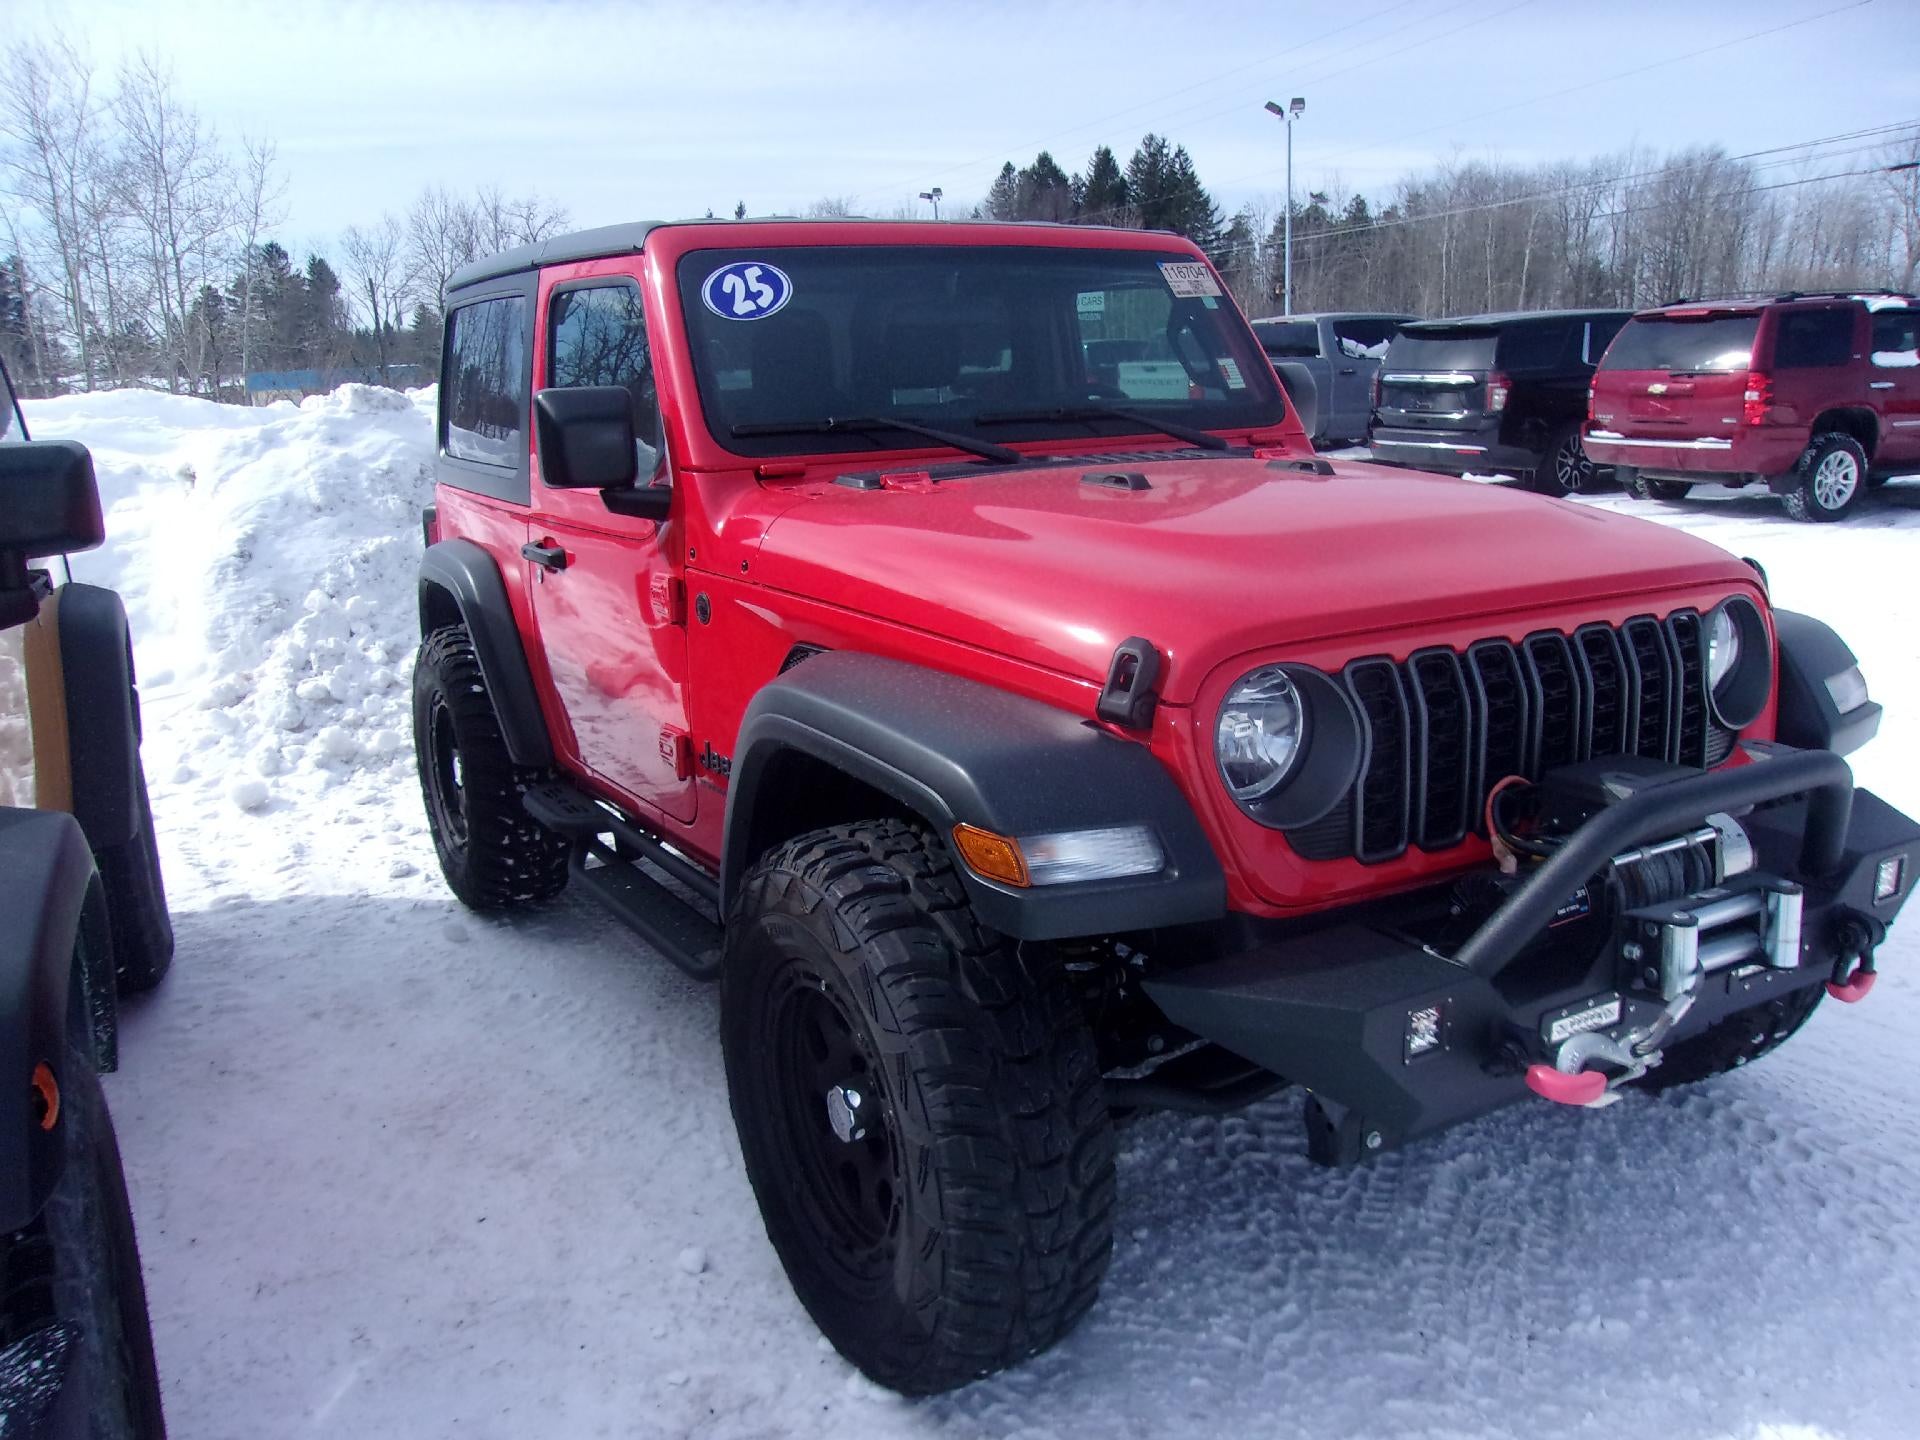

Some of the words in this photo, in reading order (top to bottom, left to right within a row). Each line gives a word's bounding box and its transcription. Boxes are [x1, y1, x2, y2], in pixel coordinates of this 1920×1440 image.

[722, 266, 774, 315] 25
[1165, 266, 1210, 280] 1167047
[699, 740, 732, 776] Jee
